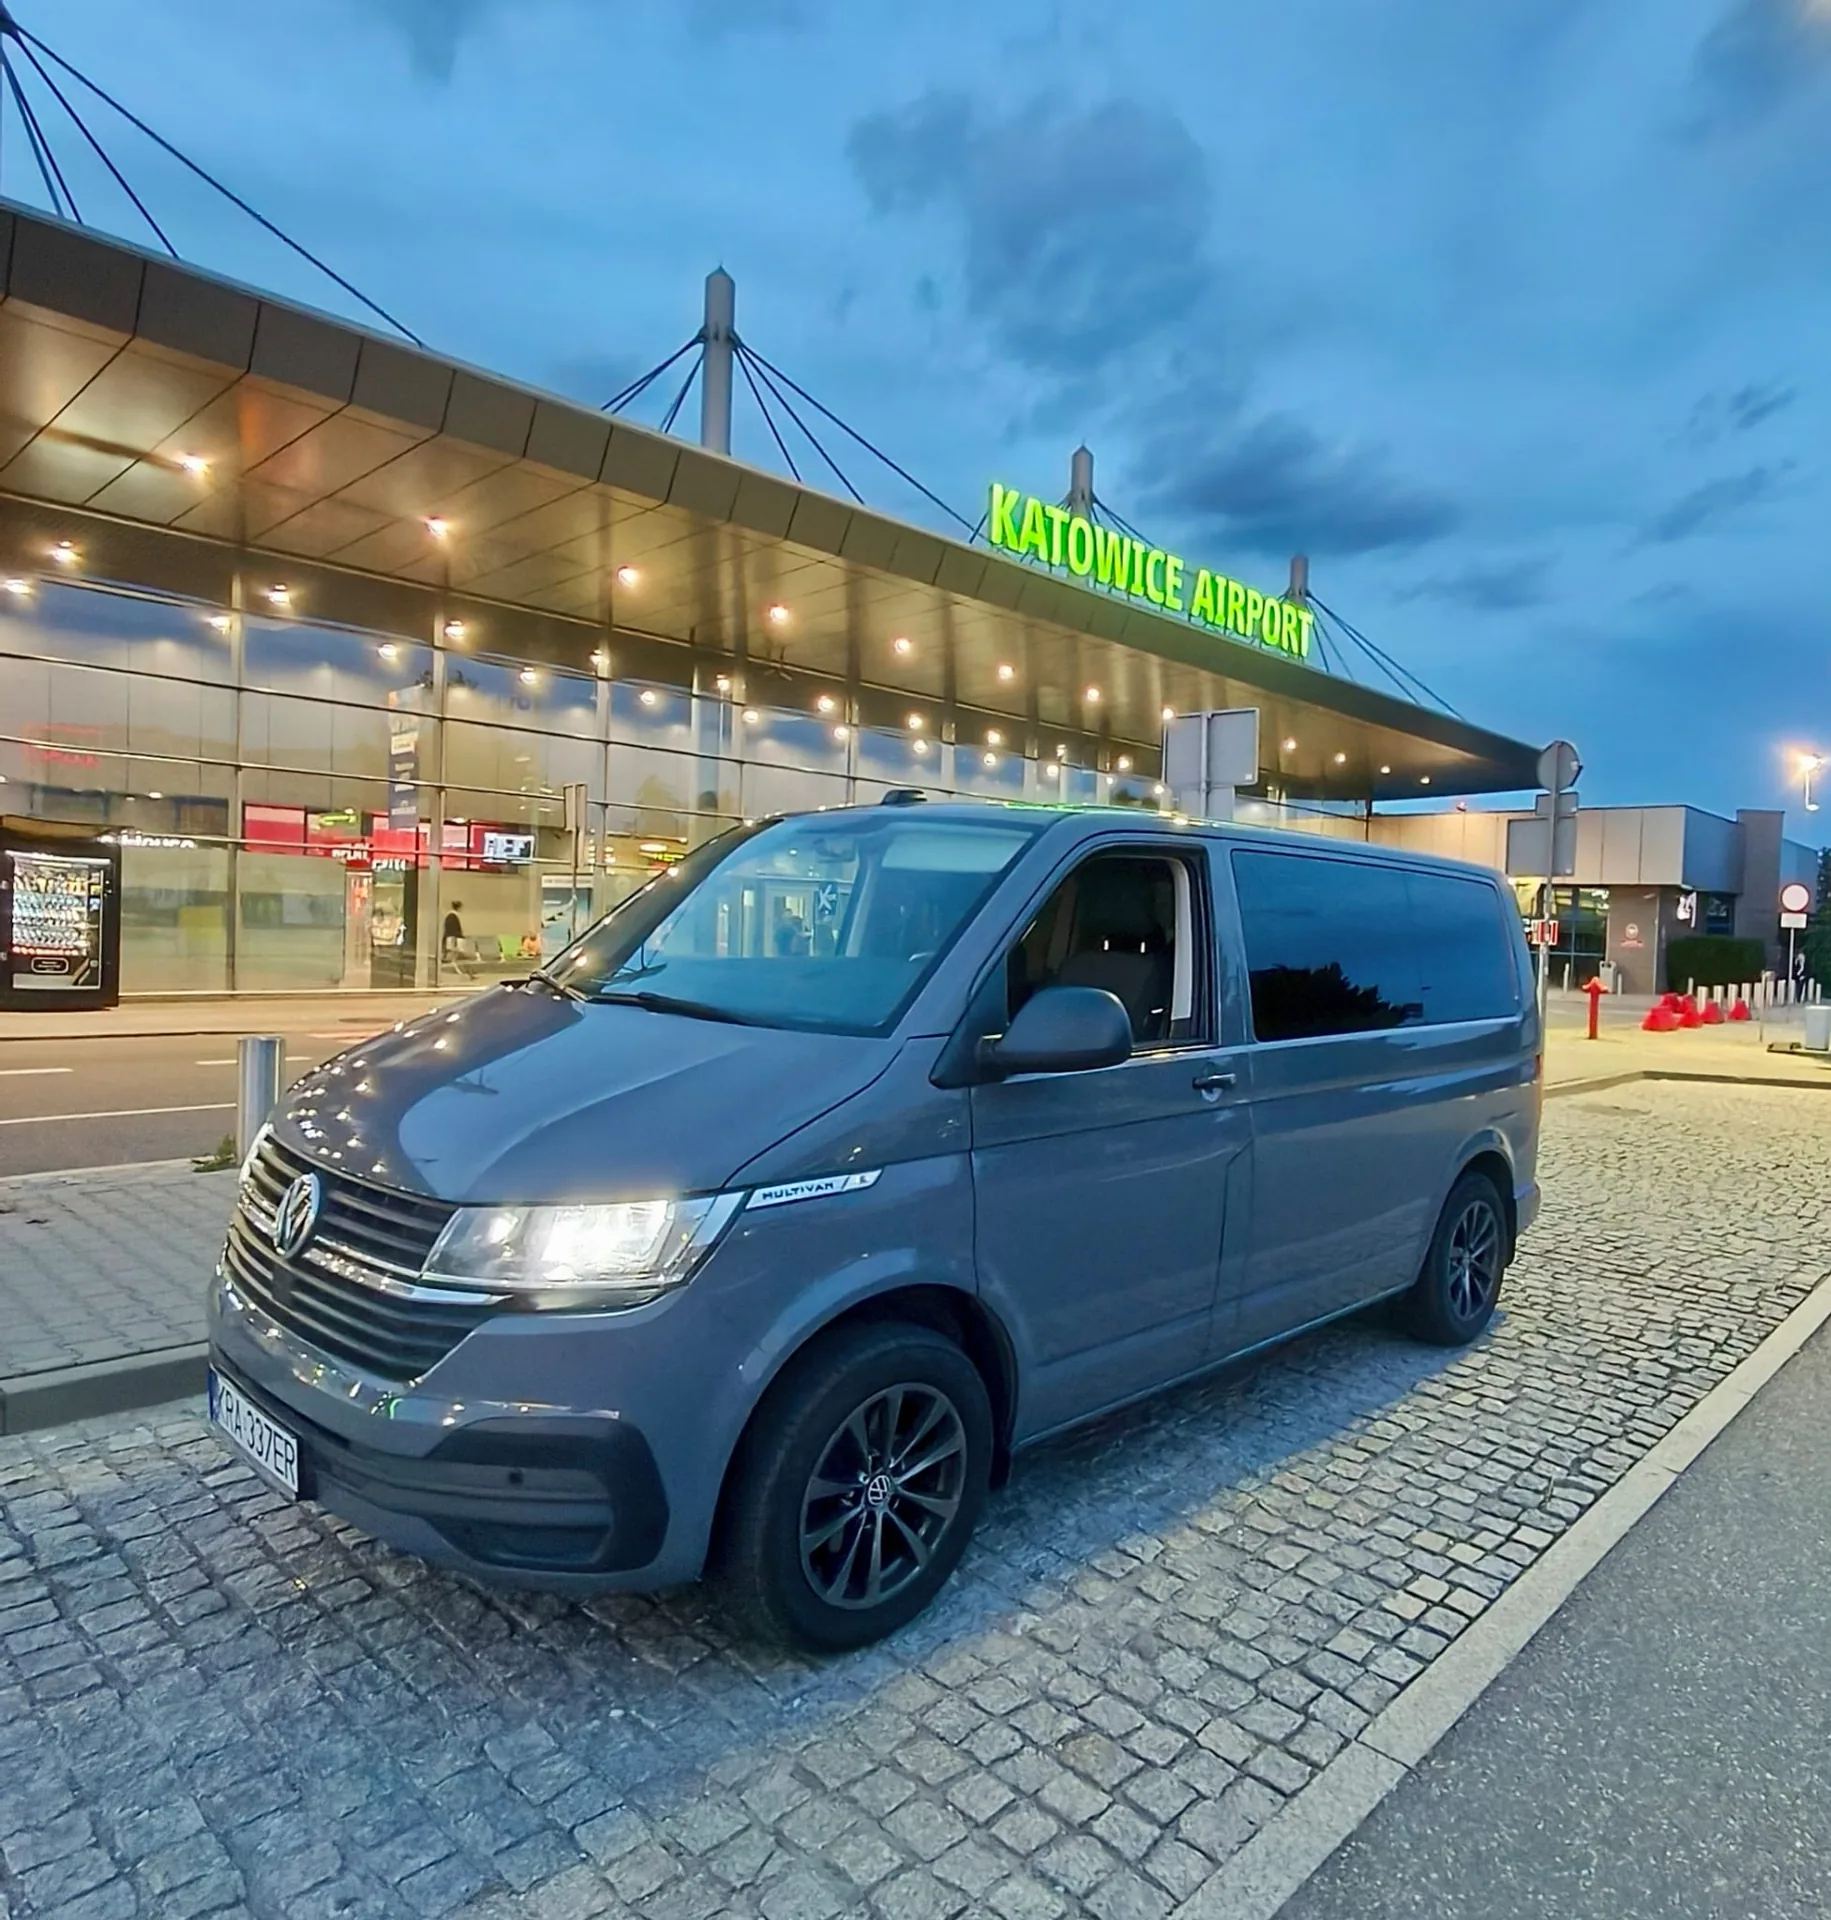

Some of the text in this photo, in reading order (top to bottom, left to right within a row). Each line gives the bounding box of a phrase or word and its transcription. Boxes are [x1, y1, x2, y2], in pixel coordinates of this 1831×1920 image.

[990, 483, 1315, 659] KATOWICE AIRPORT
[762, 1182, 834, 1200] MULTIVAN
[247, 1410, 296, 1486] 337ER
